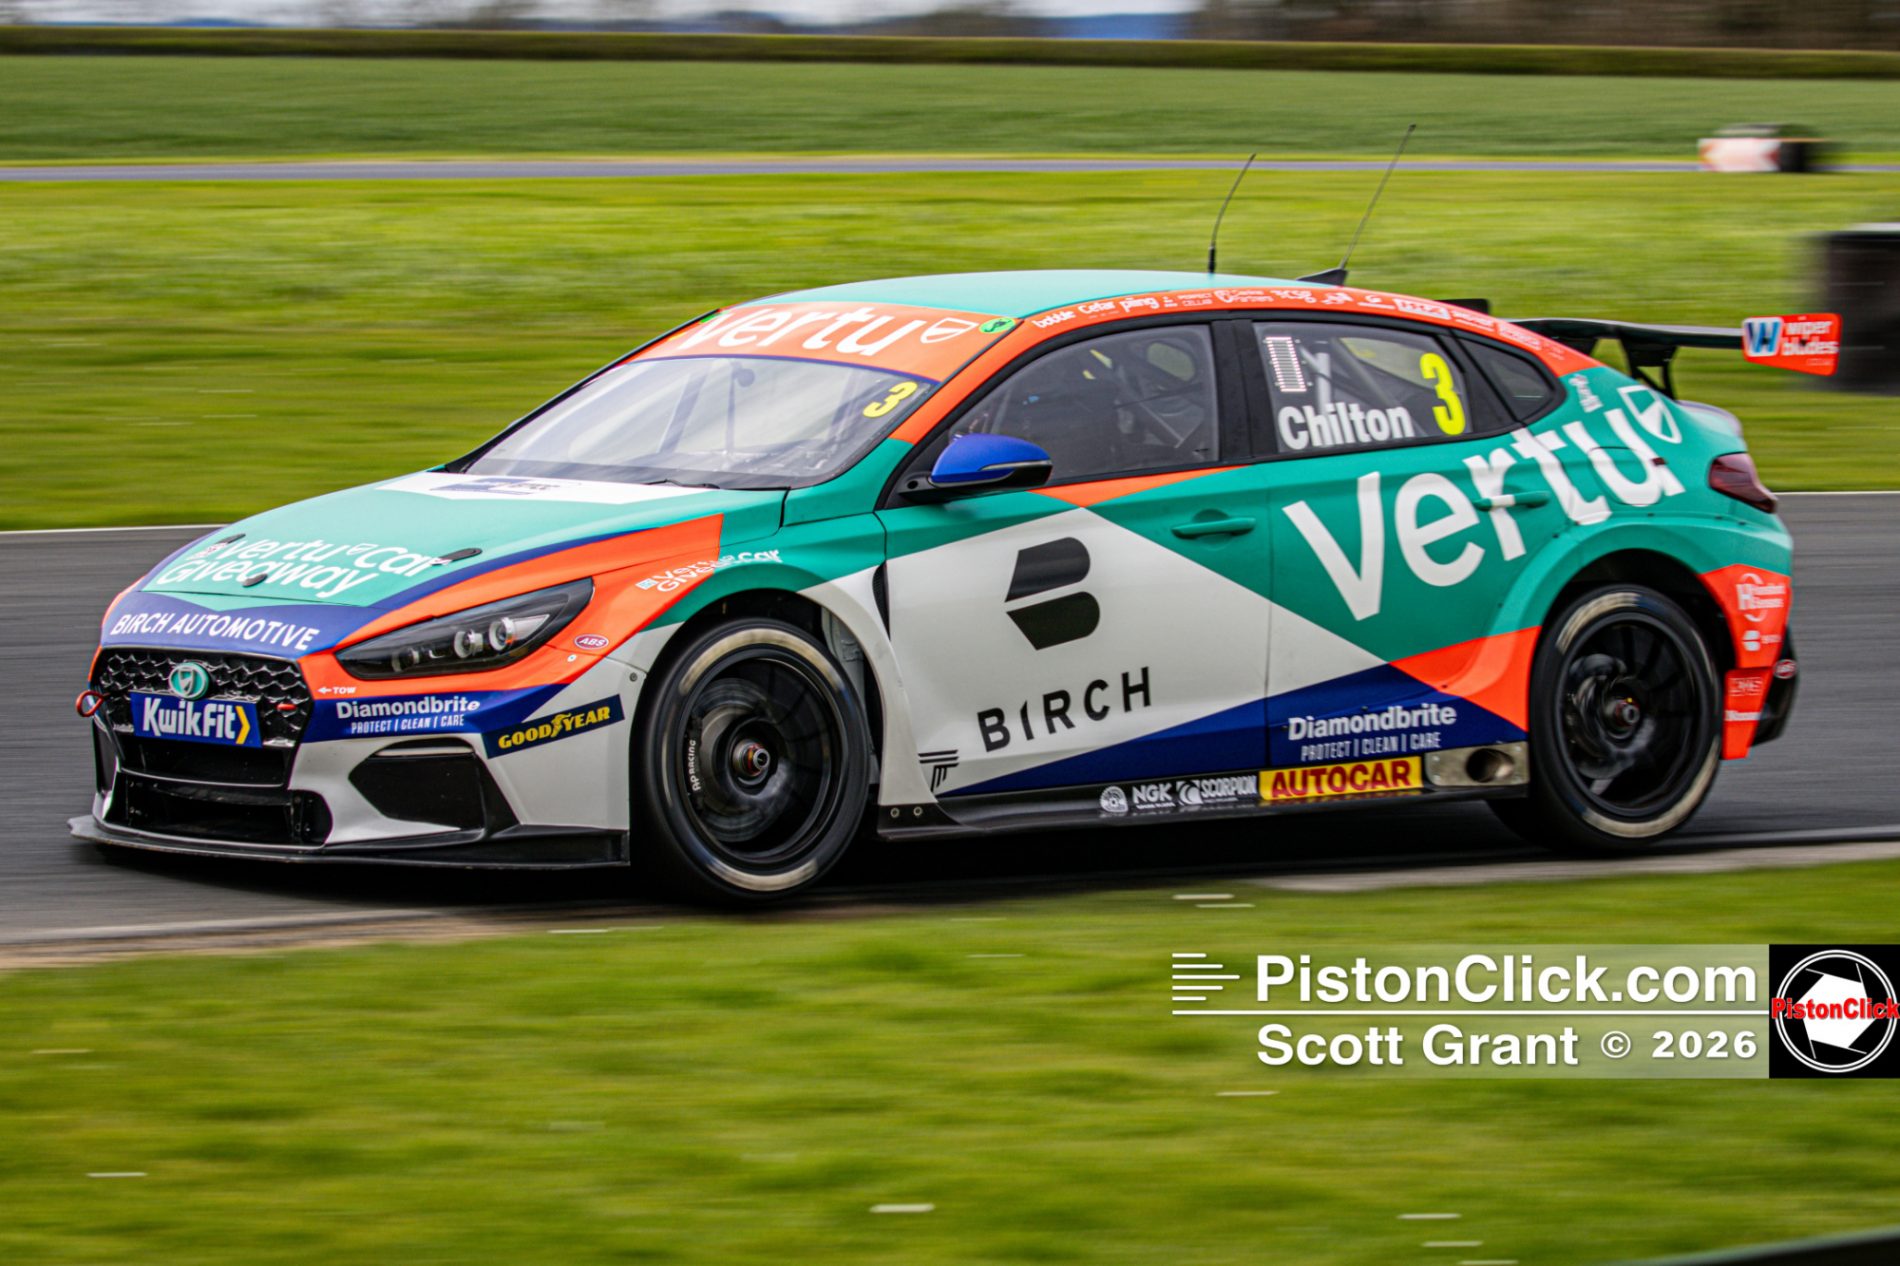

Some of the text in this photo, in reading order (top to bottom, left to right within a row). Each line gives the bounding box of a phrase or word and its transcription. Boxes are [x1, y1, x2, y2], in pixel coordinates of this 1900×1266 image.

[862, 381, 918, 419] 3
[1420, 352, 1466, 436] 3
[1278, 401, 1416, 451] Chilton
[1282, 408, 1686, 621] vertu
[157, 559, 380, 599] Giveaway
[110, 612, 320, 650] BIRCH AUTOMOTIVE
[578, 636, 606, 648] ABS
[332, 686, 357, 695] TOW
[336, 695, 481, 719] Diamondbrite
[977, 666, 1151, 753] BIRCH
[351, 714, 465, 735] PROTECT CLEAN CARE
[1288, 702, 1457, 741] Diamondbrite
[1301, 731, 1441, 762] PROTECT CLEAN CARE
[1132, 775, 1258, 804] NGK SCORPION
[1272, 759, 1411, 799] AUTOCAR
